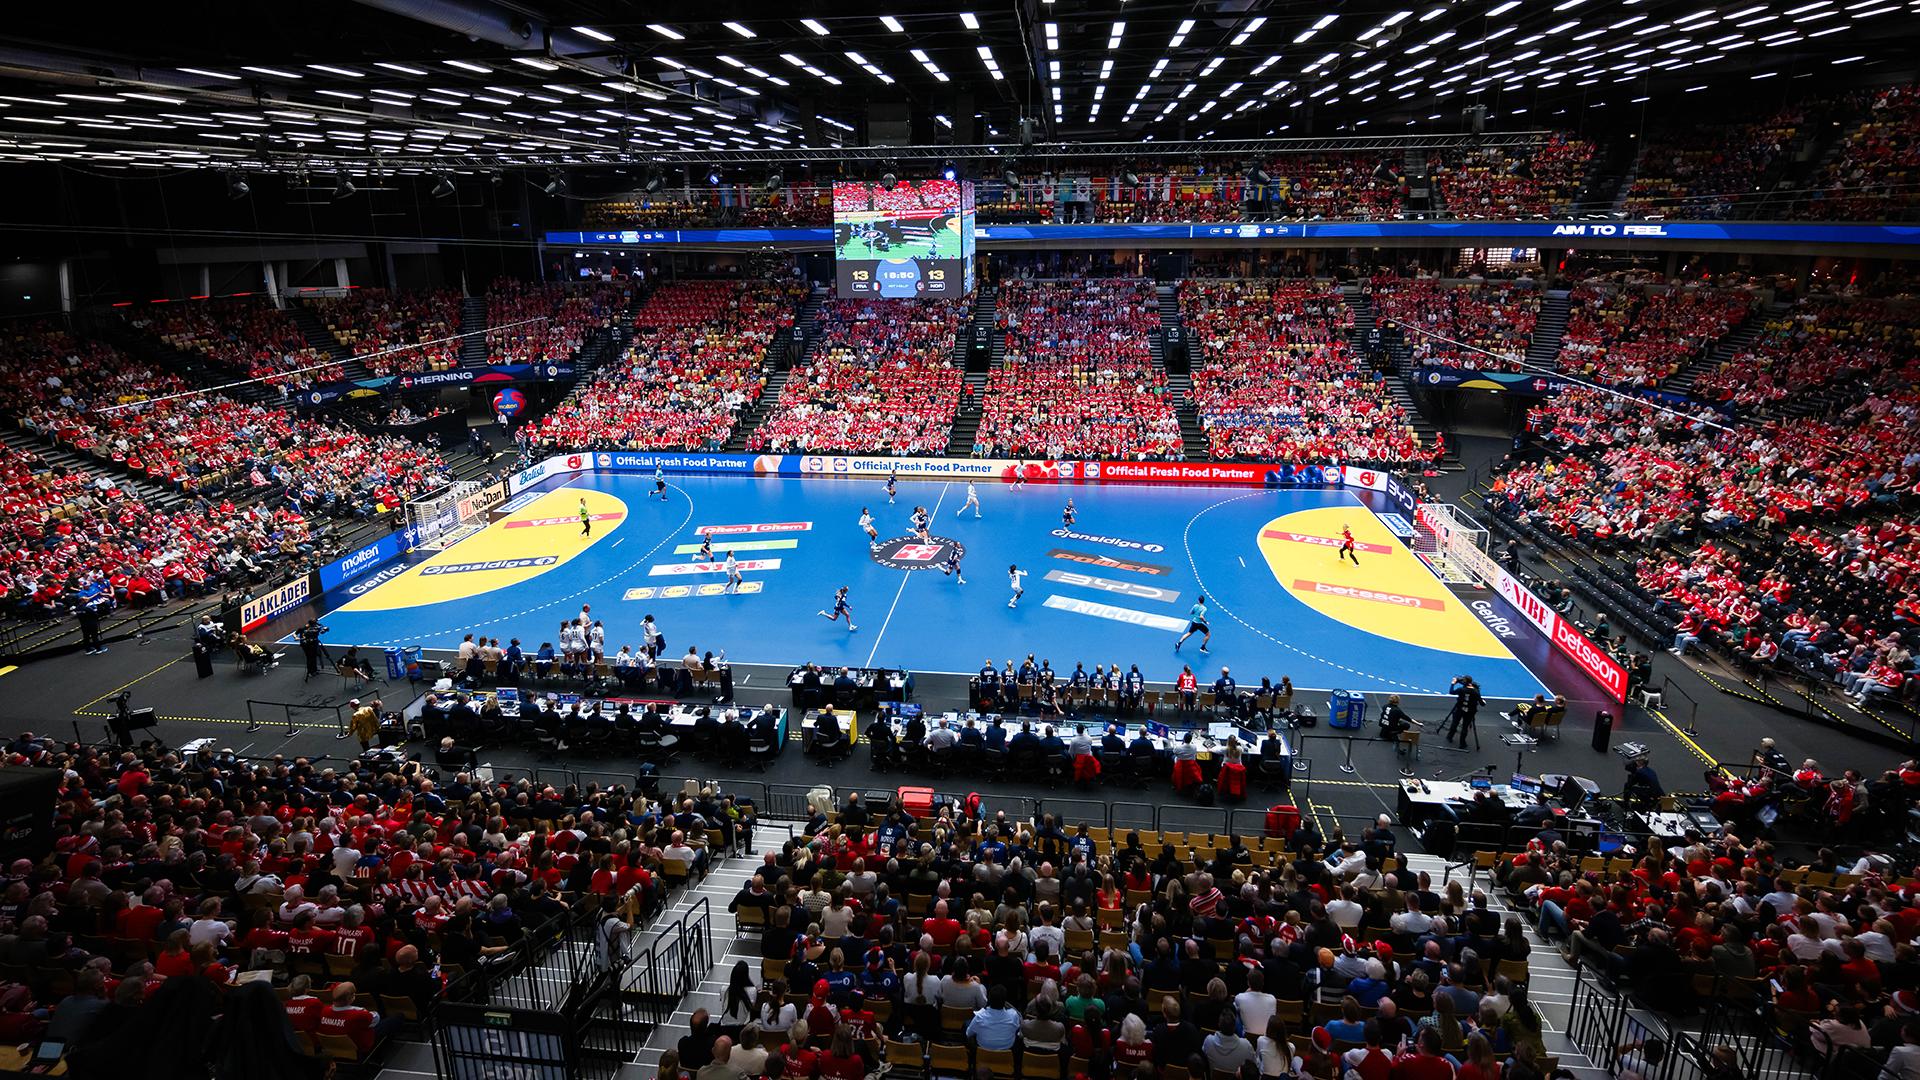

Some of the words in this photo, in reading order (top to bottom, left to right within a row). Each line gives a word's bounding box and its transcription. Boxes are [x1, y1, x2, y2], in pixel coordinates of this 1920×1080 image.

[1552, 225, 1586, 235] AIM
[1591, 225, 1616, 235] TO
[1623, 225, 1667, 235] FEEL
[852, 270, 869, 280] 13
[928, 270, 945, 280] 13
[414, 372, 473, 385] HERNING
[616, 456, 653, 466] Official
[655, 458, 681, 467] Fresh
[683, 459, 708, 467] Food
[710, 459, 747, 468] Partner
[853, 461, 892, 471] Official
[895, 461, 922, 471] Fresh
[924, 462, 950, 472] Food
[953, 463, 992, 473] Partner
[1106, 466, 1148, 476] Official
[1150, 466, 1179, 477] Fresh
[1182, 467, 1210, 477] Food
[1212, 468, 1255, 478] Partner
[471, 490, 502, 510] NoDan
[1051, 529, 1142, 548] Gjensidige
[342, 546, 379, 571] molten
[1054, 553, 1161, 575] POWER
[423, 558, 531, 575] Gjensidige
[349, 562, 409, 595] Gerflor
[1315, 582, 1422, 607] betsson
[244, 580, 309, 624] BLÅKLÄDER
[1511, 583, 1549, 629] NIBE
[1471, 600, 1516, 638] Gerflor
[1557, 620, 1620, 689] betsson
[1005, 676, 1015, 685] 25
[1183, 680, 1193, 688] 12
[358, 866, 370, 878] 10
[338, 927, 364, 937] DANMARK
[289, 937, 314, 945] DANMARK
[337, 936, 356, 957] 10
[286, 1006, 306, 1014] NMARK
[321, 1017, 345, 1027] DANMARK
